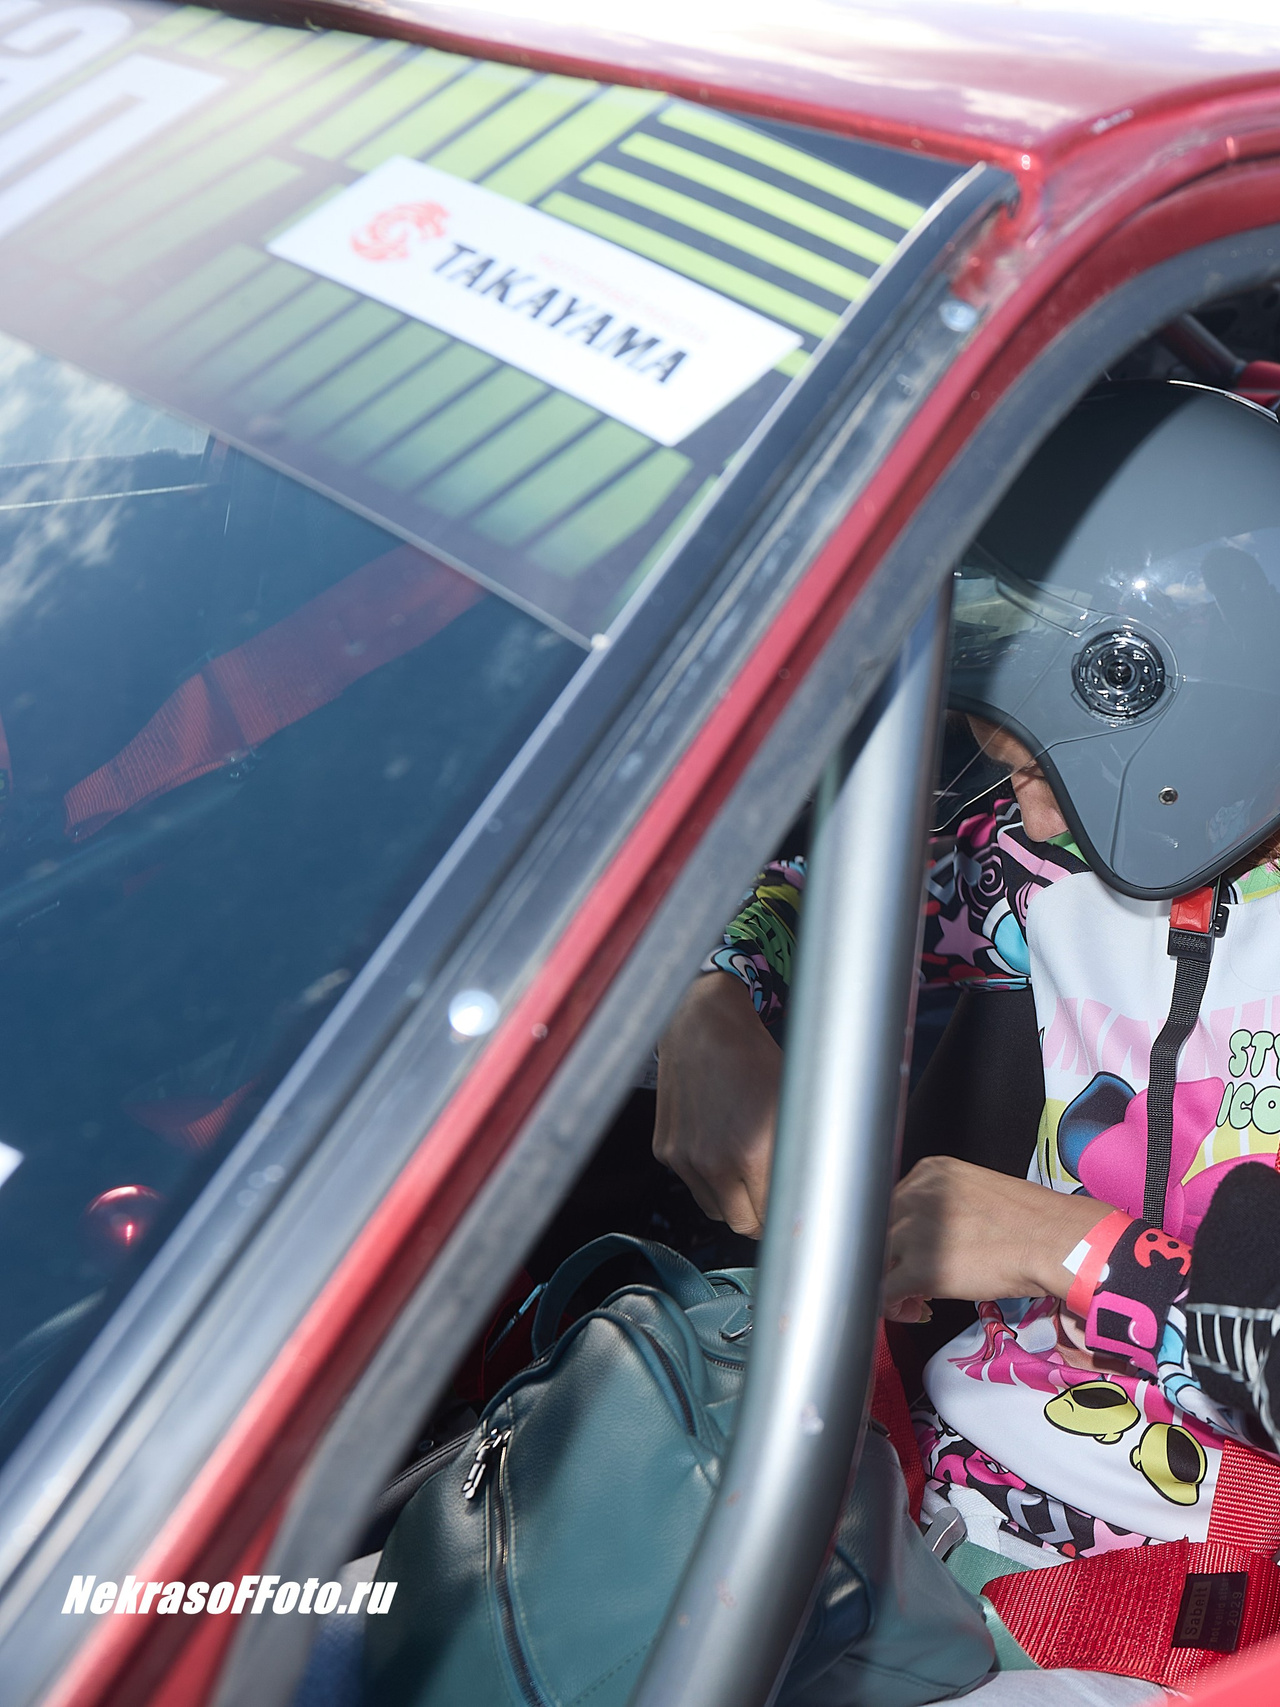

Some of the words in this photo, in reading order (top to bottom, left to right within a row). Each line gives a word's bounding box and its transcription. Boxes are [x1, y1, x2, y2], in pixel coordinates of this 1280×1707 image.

[433, 242, 688, 384] TAKAYAMA
[1184, 1586, 1208, 1636] Sabelt
[1226, 1591, 1243, 1627] 2029
